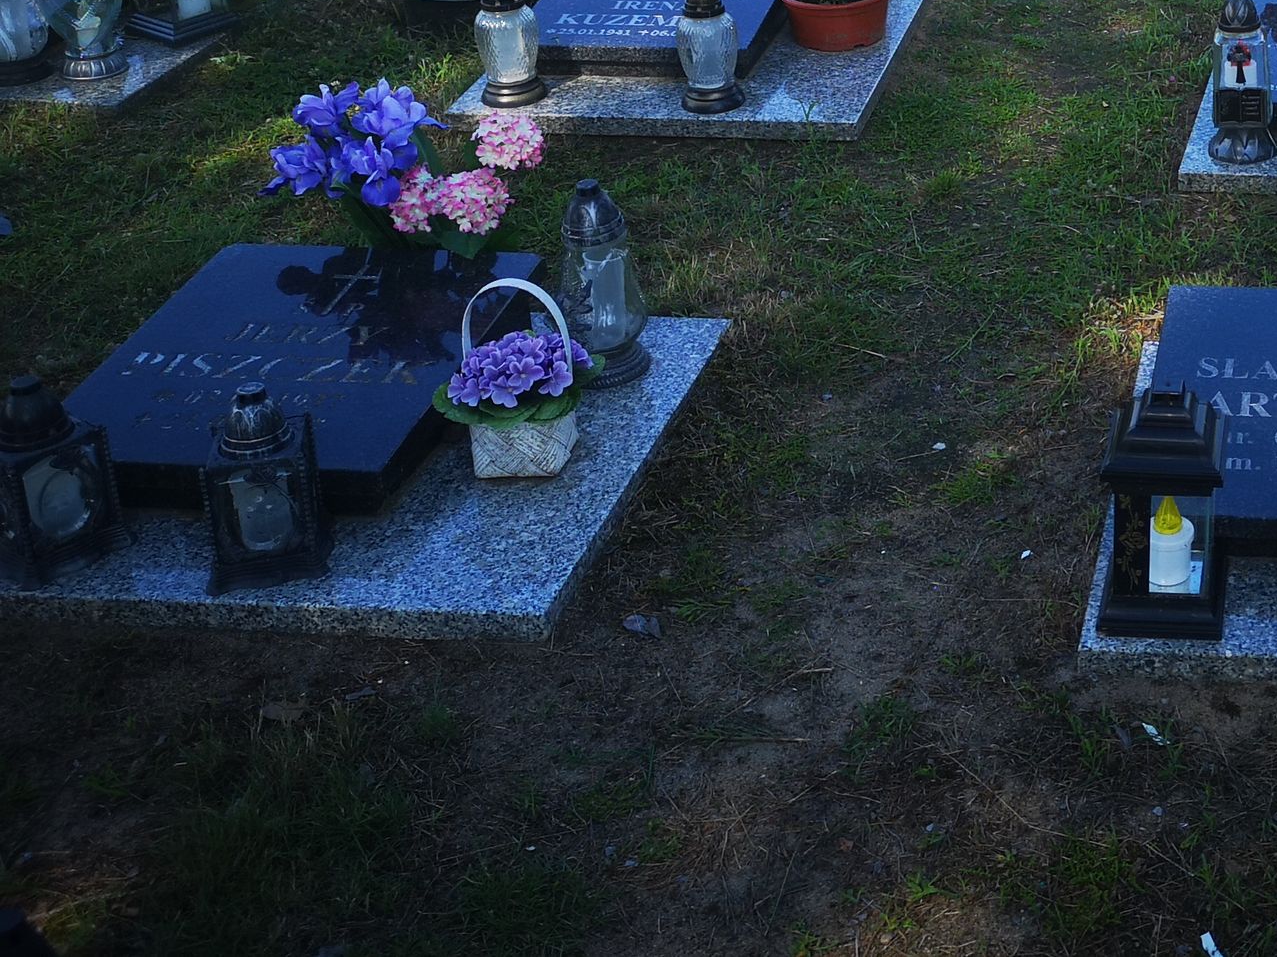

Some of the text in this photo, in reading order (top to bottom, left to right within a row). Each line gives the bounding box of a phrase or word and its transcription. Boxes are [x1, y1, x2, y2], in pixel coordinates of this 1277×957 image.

[554, 13, 684, 27] KUZEM
[119, 351, 419, 385] PISZCZEK
[1225, 456, 1261, 471] m.
